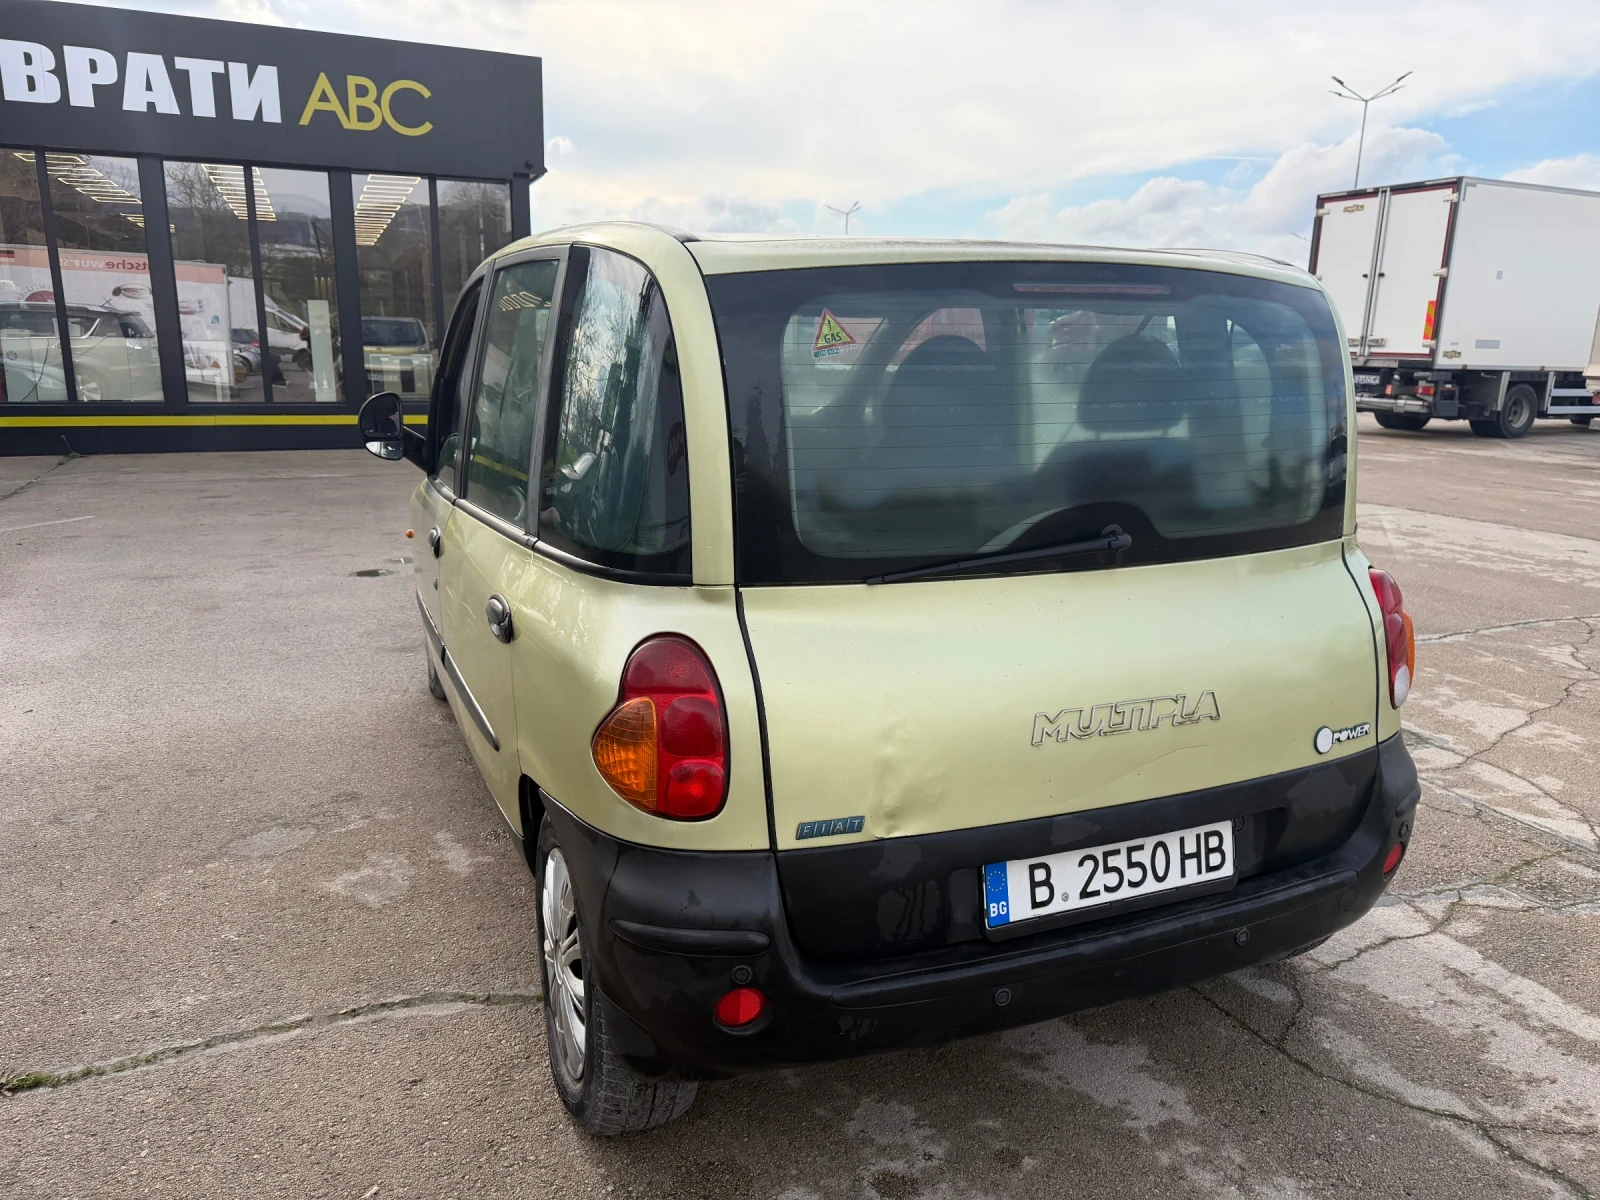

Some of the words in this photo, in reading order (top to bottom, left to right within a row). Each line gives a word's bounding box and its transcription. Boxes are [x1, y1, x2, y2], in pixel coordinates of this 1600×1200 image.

[0, 38, 282, 123] ВРАТИ
[299, 72, 433, 136] ABC
[824, 332, 842, 343] GAS
[1031, 690, 1221, 746] MULTIPLA
[1333, 722, 1371, 744] POWER
[802, 819, 861, 837] FIAT
[1077, 840, 1171, 900] 2550
[1179, 829, 1226, 879] HB
[989, 901, 1008, 918] BG
